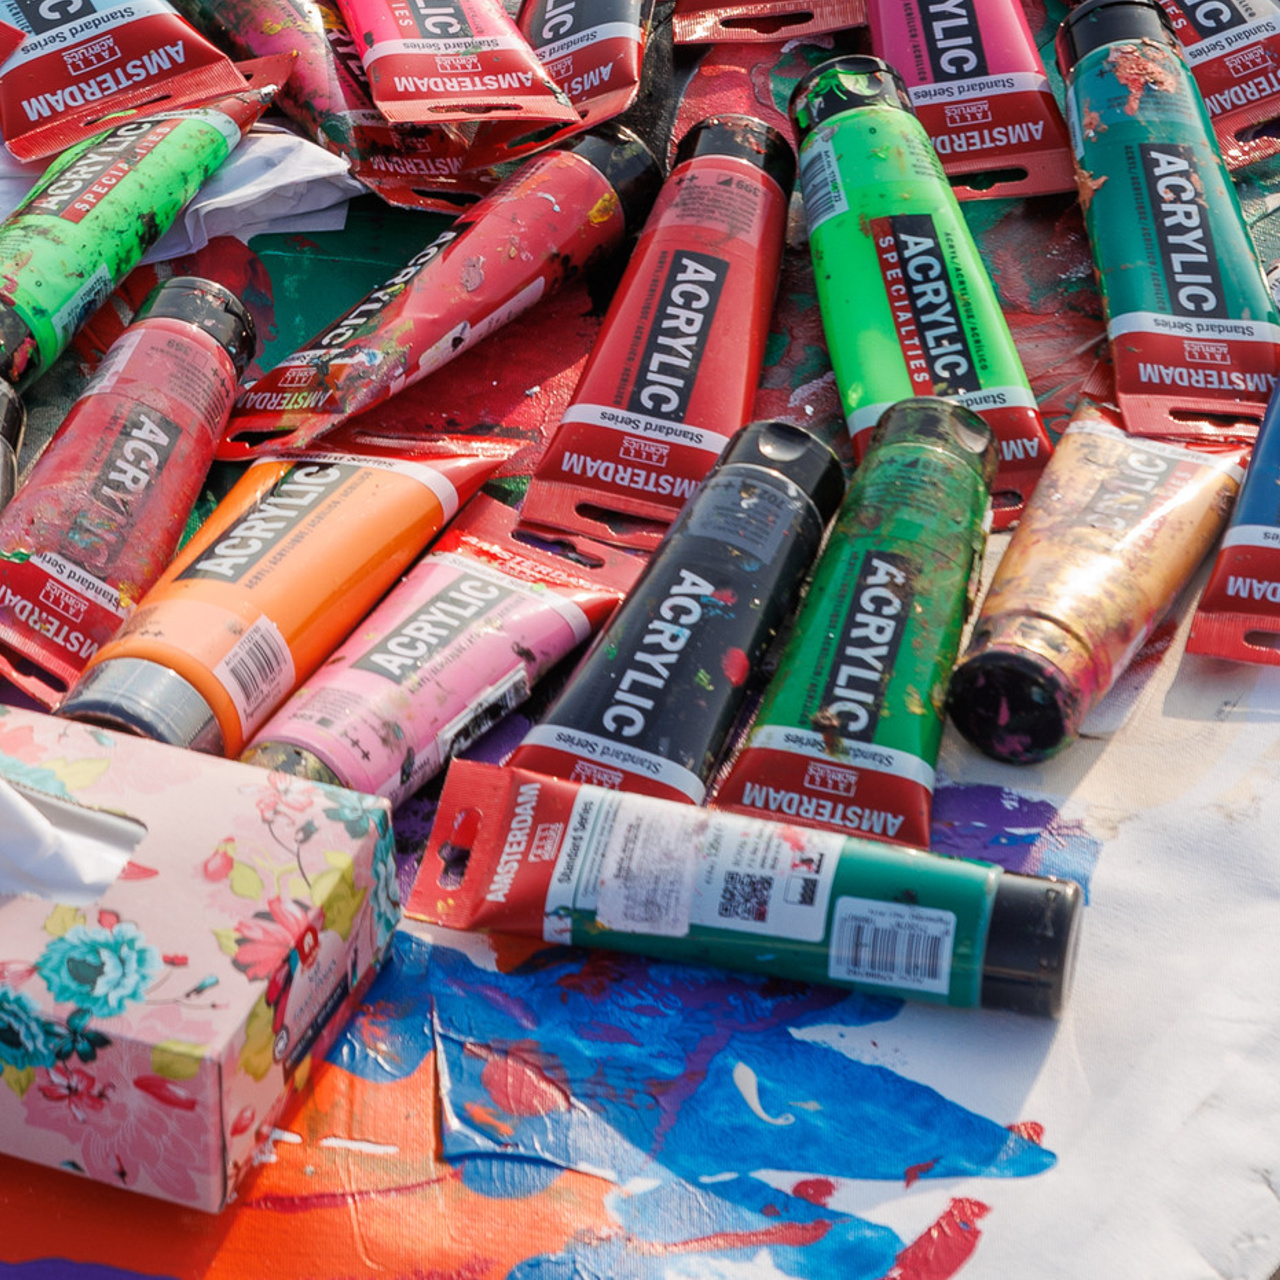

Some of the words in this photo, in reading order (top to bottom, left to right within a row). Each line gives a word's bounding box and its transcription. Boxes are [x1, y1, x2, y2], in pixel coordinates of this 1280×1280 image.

[69, 6, 135, 39] Standard
[1223, 21, 1276, 47] Standard
[21, 31, 67, 56] Series
[62, 35, 115, 66] ACRYLICS
[403, 42, 441, 51] Series
[549, 30, 598, 59] Standard
[1189, 42, 1223, 61] Series
[22, 39, 187, 122] AMSTERDAM
[395, 69, 534, 93] AMSTERDAM
[914, 85, 954, 100] Series
[957, 78, 1016, 96] Standard
[932, 120, 1045, 154] AMSTERD
[40, 120, 154, 211] ACRYLIC
[74, 126, 172, 212] SPECIALTIES
[1150, 150, 1217, 314] ACRYLIC
[879, 235, 931, 384] SPECIALTIES
[899, 234, 970, 382] ACRYLIC
[1154, 316, 1194, 330] Series
[640, 257, 718, 414] ACRYLIC
[1197, 318, 1255, 337] Standard
[600, 411, 635, 425] Series
[639, 420, 704, 444] Standard
[196, 464, 341, 578] ACRYLIC
[66, 564, 121, 608] Standard
[371, 578, 501, 681] ACRYLIC
[835, 557, 907, 732] ACRYLIC
[602, 567, 715, 738] ACRYLIC
[555, 729, 596, 754] Series
[597, 738, 663, 775] Standard
[743, 780, 905, 837] AMSTERDAM
[486, 783, 542, 903] AMSTERDAM
[559, 831, 584, 885] Standard
